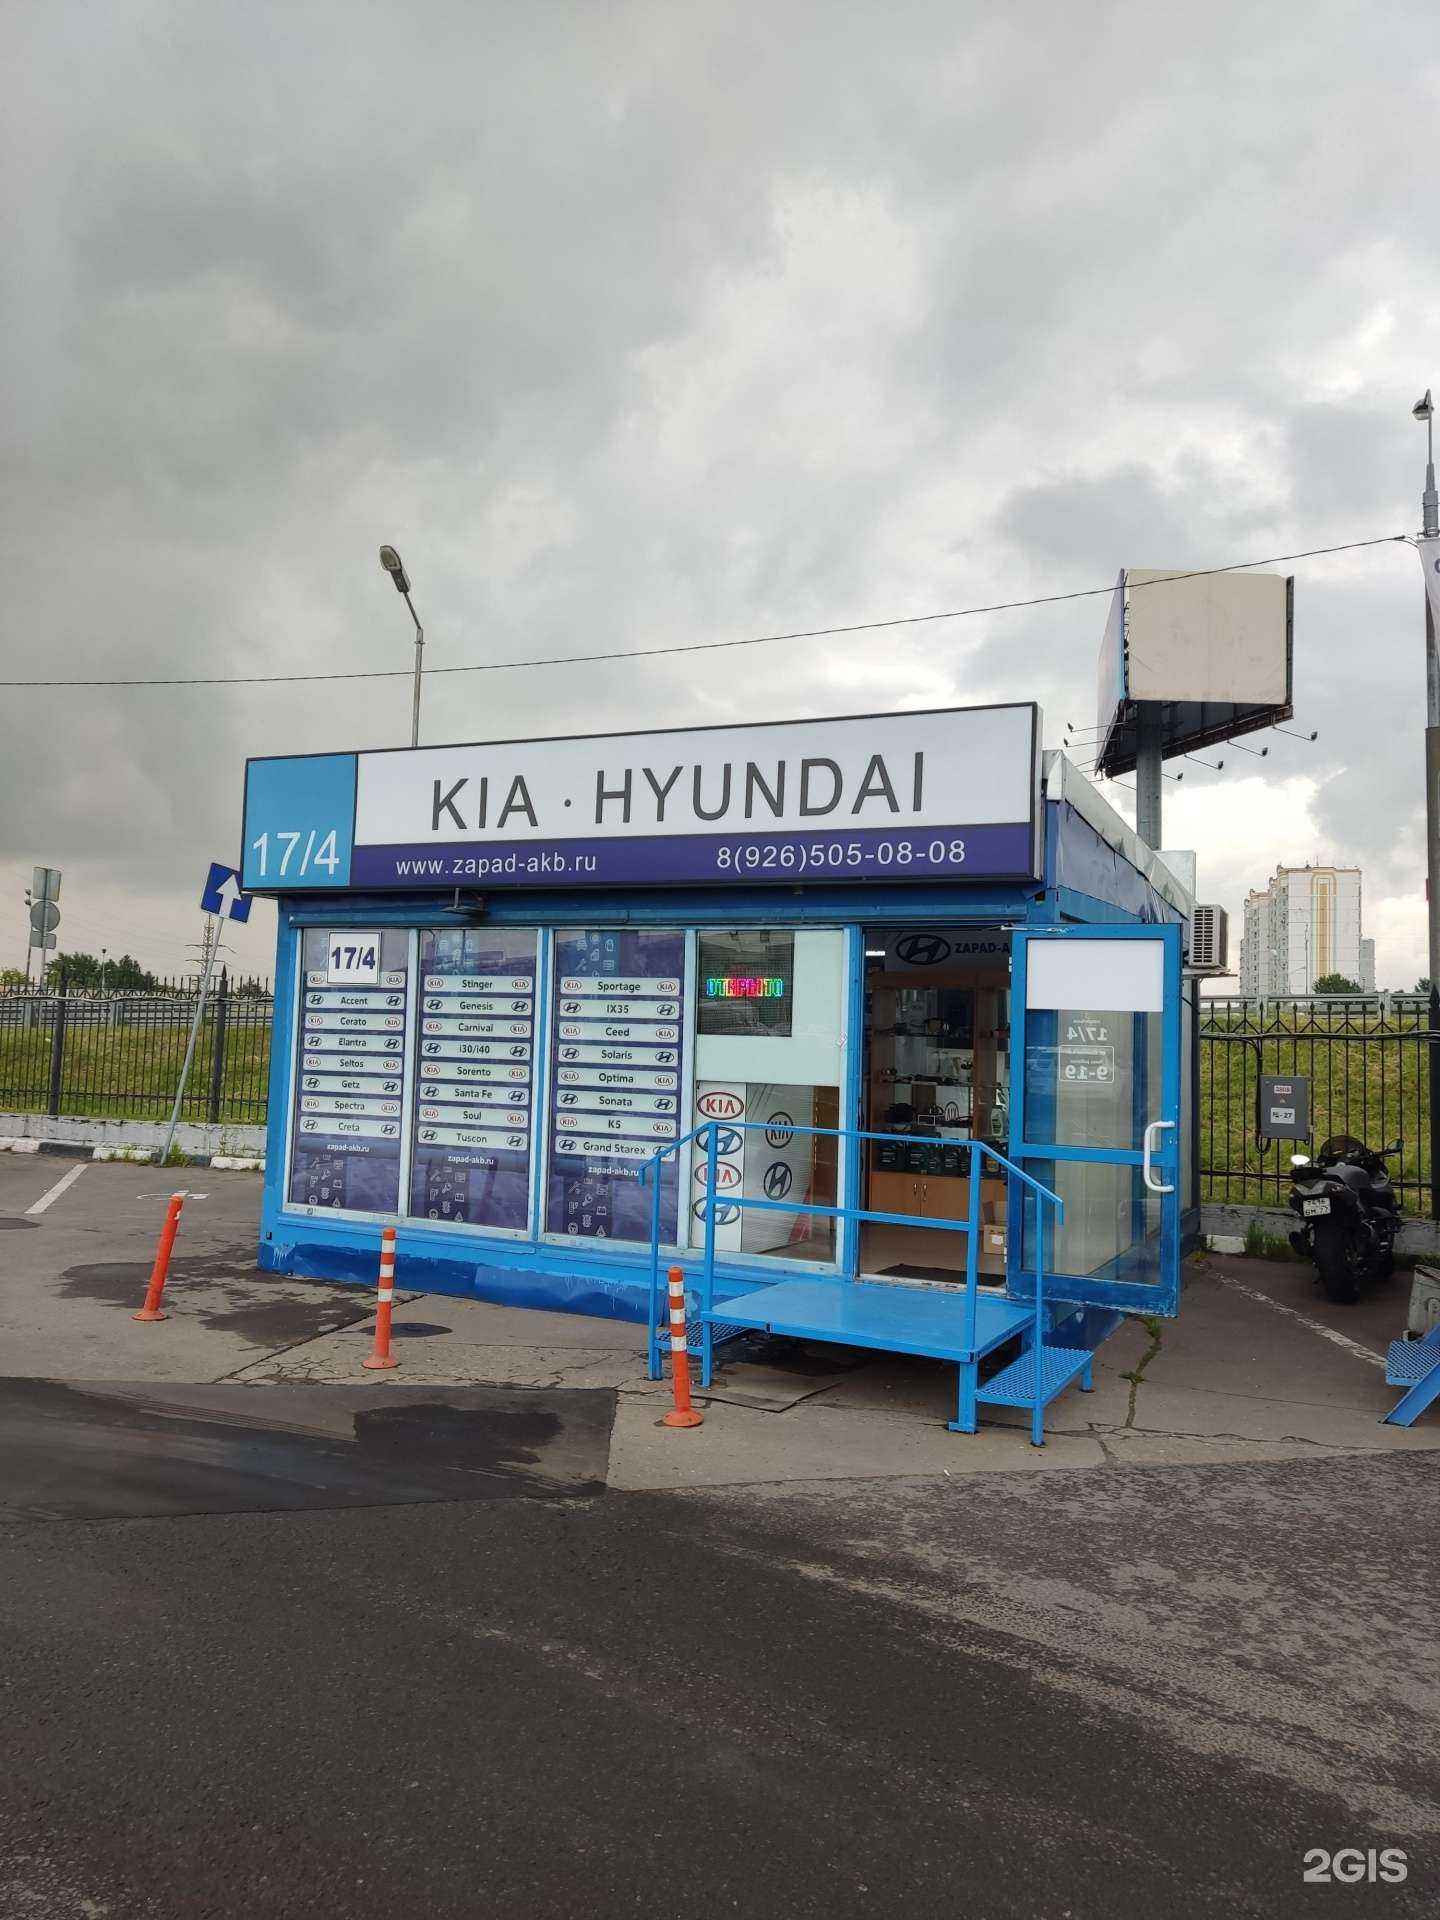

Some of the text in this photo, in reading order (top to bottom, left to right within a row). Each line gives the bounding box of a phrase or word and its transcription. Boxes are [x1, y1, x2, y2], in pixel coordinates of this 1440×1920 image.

[431, 751, 924, 831] KIA HYUNDAI
[252, 830, 340, 877] 17/4
[716, 839, 966, 873] 8(926)505-08-08
[331, 946, 376, 970] 17/4
[462, 980, 493, 990] Stinger
[597, 981, 641, 993] Sportage
[340, 996, 368, 1005] Accent
[459, 1001, 494, 1011] Genesis
[340, 1017, 367, 1026] Cerato
[458, 1022, 494, 1032] Carnival
[605, 1027, 630, 1037] Ceed
[338, 1037, 367, 1047] Elantra
[601, 1049, 633, 1060] Solaris
[339, 1059, 364, 1068] Seltos
[456, 1066, 491, 1076] Sorento
[598, 1072, 634, 1084] Optima
[341, 1080, 360, 1089] Getz
[454, 1088, 493, 1099] Santa Fe
[334, 1101, 365, 1110] Spectra
[599, 1095, 633, 1107] Sonata
[706, 1098, 735, 1114] KIA
[463, 1110, 482, 1120] Soul
[338, 1122, 360, 1132] Creta
[608, 1120, 621, 1129] K5
[456, 1132, 488, 1143] Tuscon
[583, 1141, 646, 1155] Grand Starex
[588, 1166, 639, 1177] zapad-akb.ru
